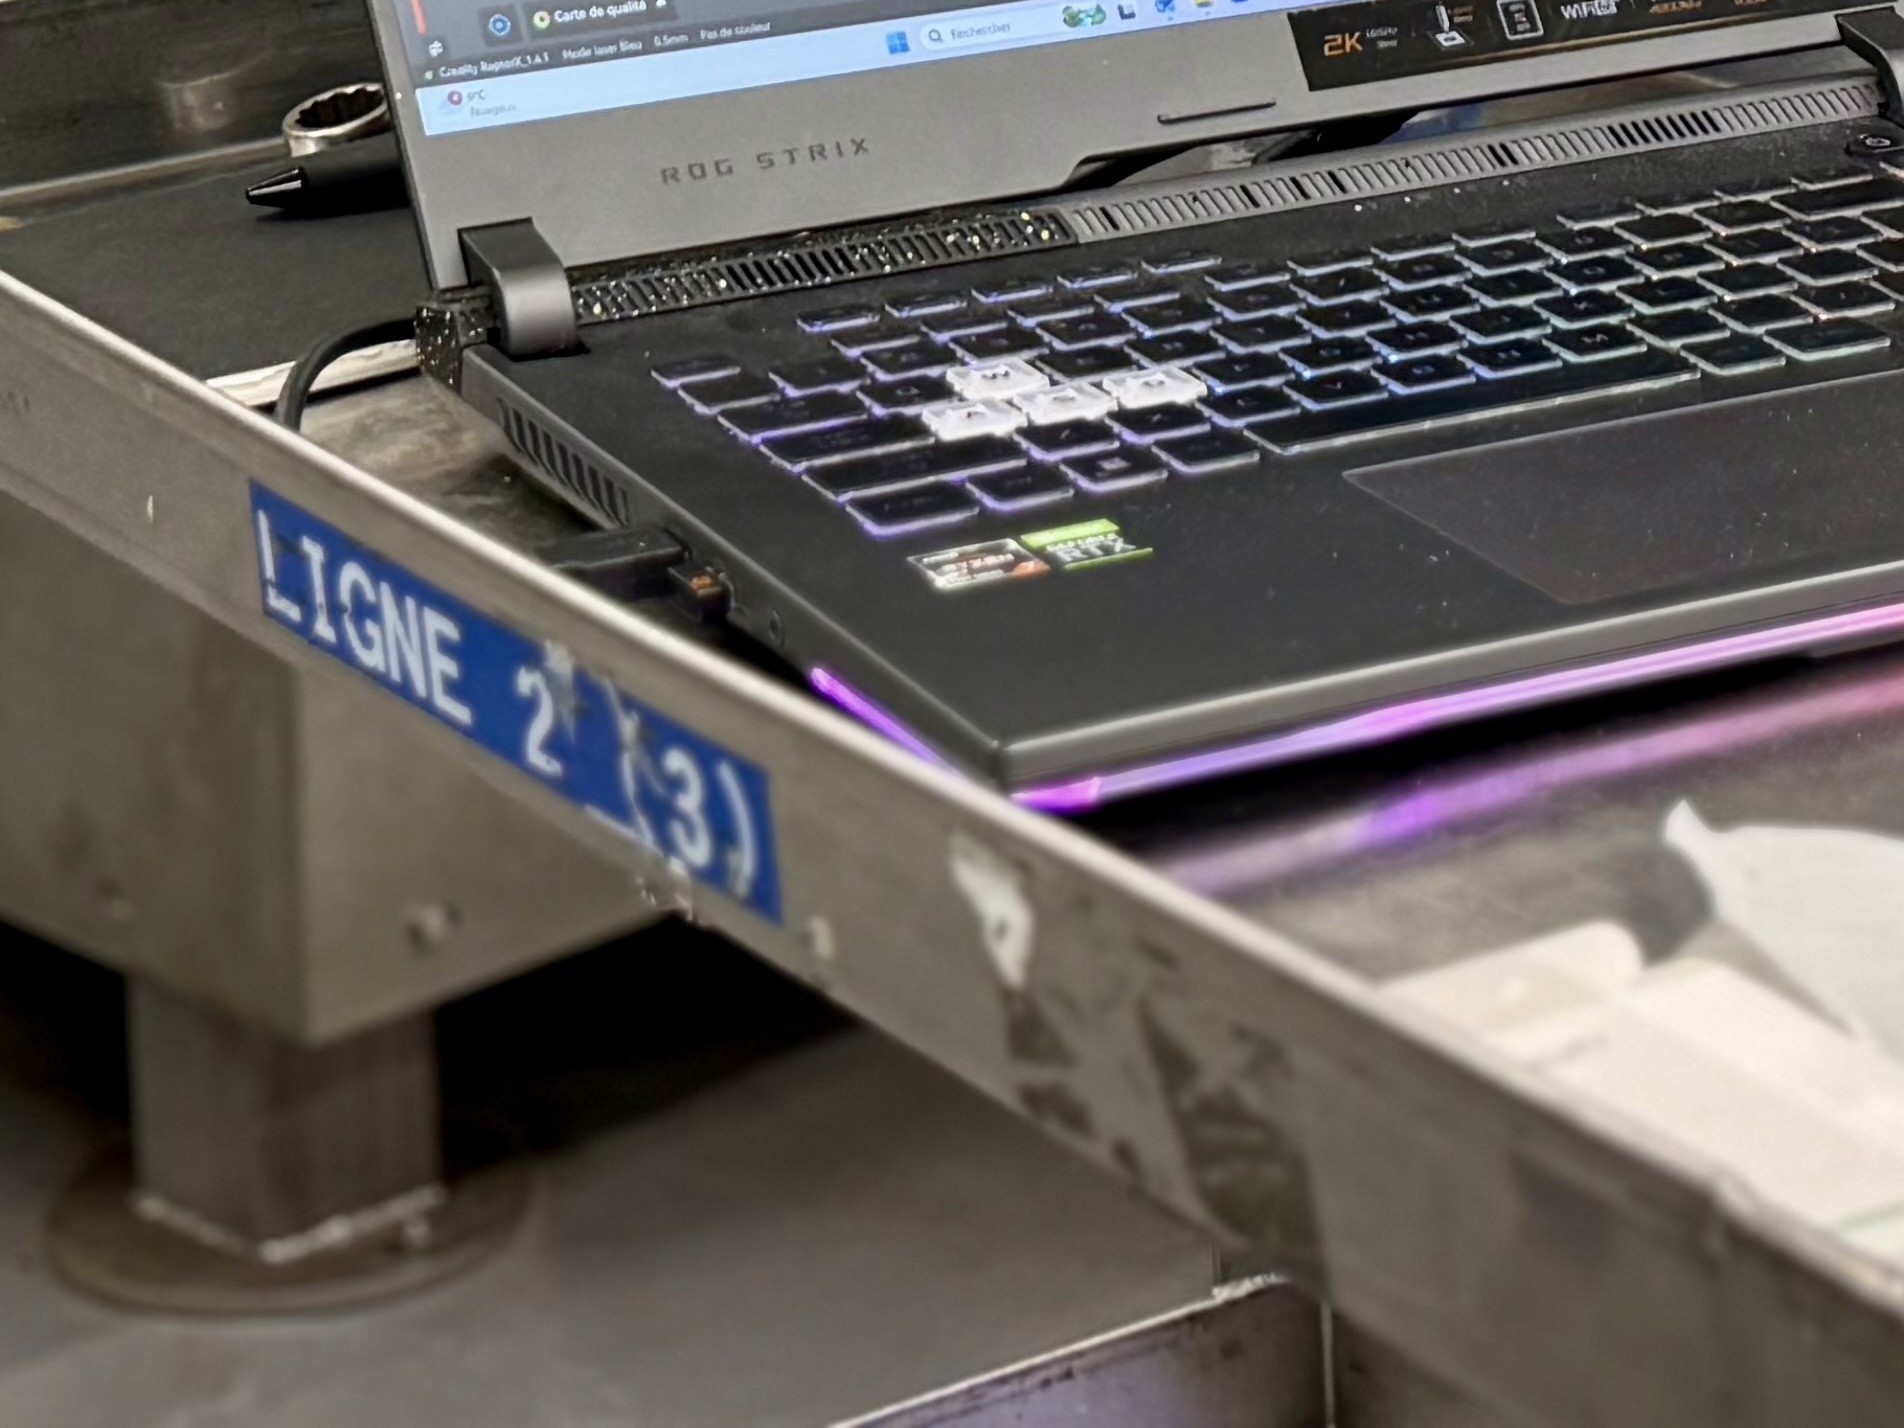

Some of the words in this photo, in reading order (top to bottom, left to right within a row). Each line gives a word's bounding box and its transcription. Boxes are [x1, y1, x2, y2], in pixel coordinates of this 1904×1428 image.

[553, 9, 587, 23] Carte
[588, 5, 605, 19] de
[1323, 31, 1364, 57] 2K
[660, 157, 735, 186] ROG
[755, 137, 870, 171] STRIX
[257, 508, 475, 728] LIGNE
[515, 666, 564, 778] 2
[616, 704, 759, 900] (3)
